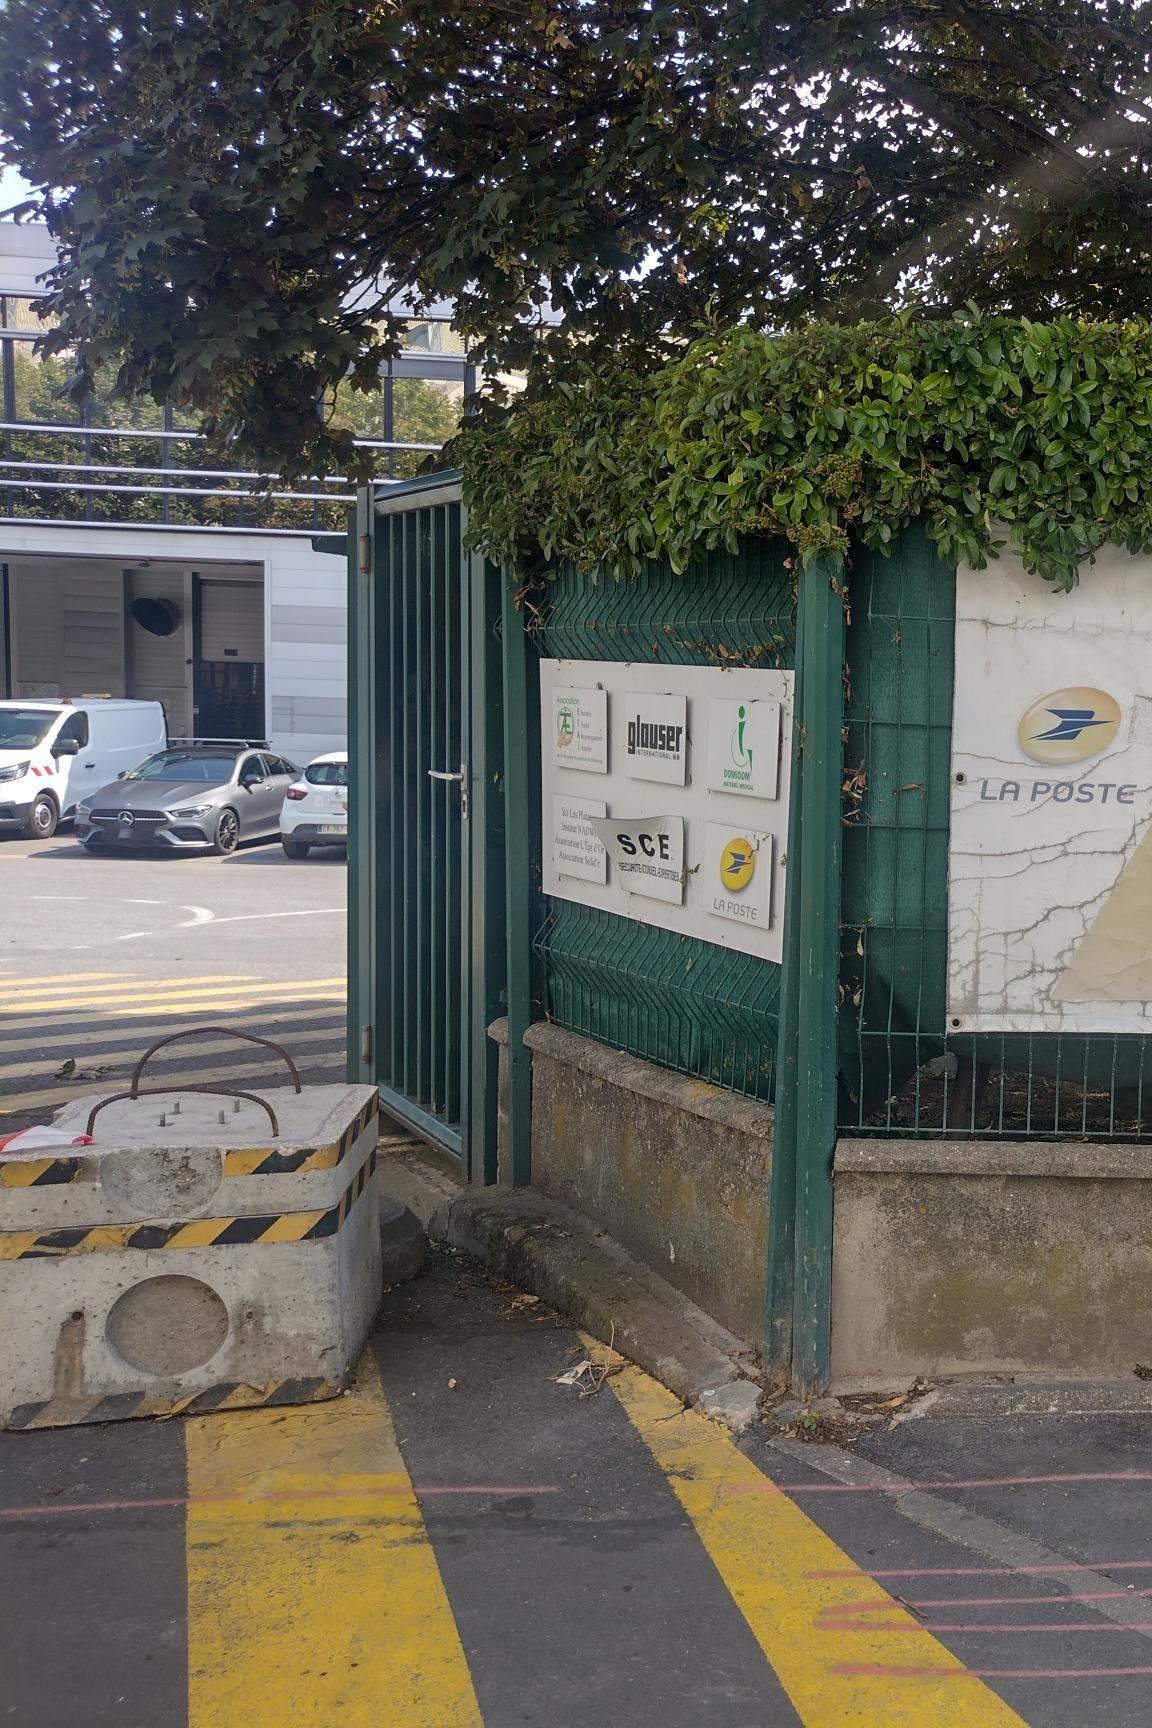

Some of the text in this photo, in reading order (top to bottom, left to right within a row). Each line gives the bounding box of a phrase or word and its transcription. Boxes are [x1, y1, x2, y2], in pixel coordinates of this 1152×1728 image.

[627, 715, 683, 754] glauser
[723, 769, 751, 781] DOMIDOM
[980, 780, 1138, 804] LA POSTE
[616, 833, 669, 861] SCE
[713, 896, 758, 920] LA POSTE
